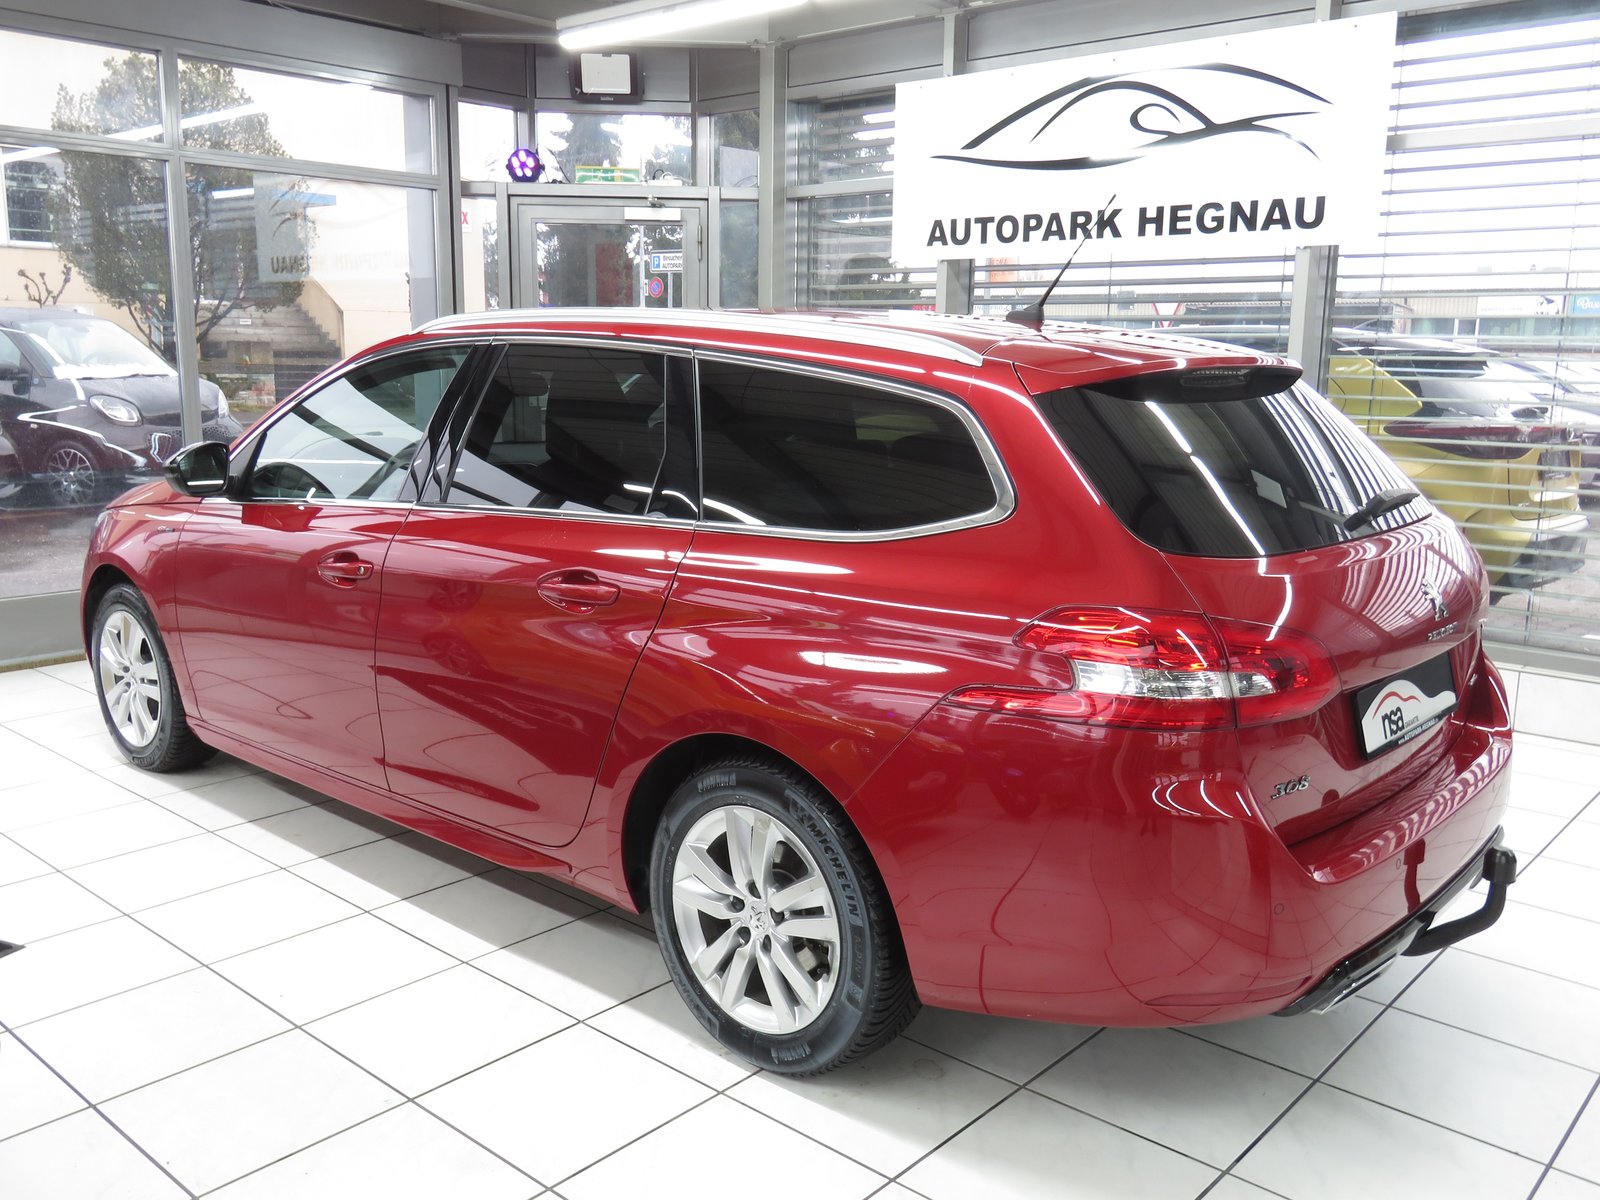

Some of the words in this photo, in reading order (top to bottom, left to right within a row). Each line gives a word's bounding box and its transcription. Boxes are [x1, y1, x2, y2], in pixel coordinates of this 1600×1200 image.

[926, 208, 1123, 247] AUTOPARK
[1137, 196, 1326, 238] HEGNAU
[1381, 706, 1405, 740] nsa
[1271, 774, 1311, 800] 308
[806, 821, 861, 918] MICHELIN
